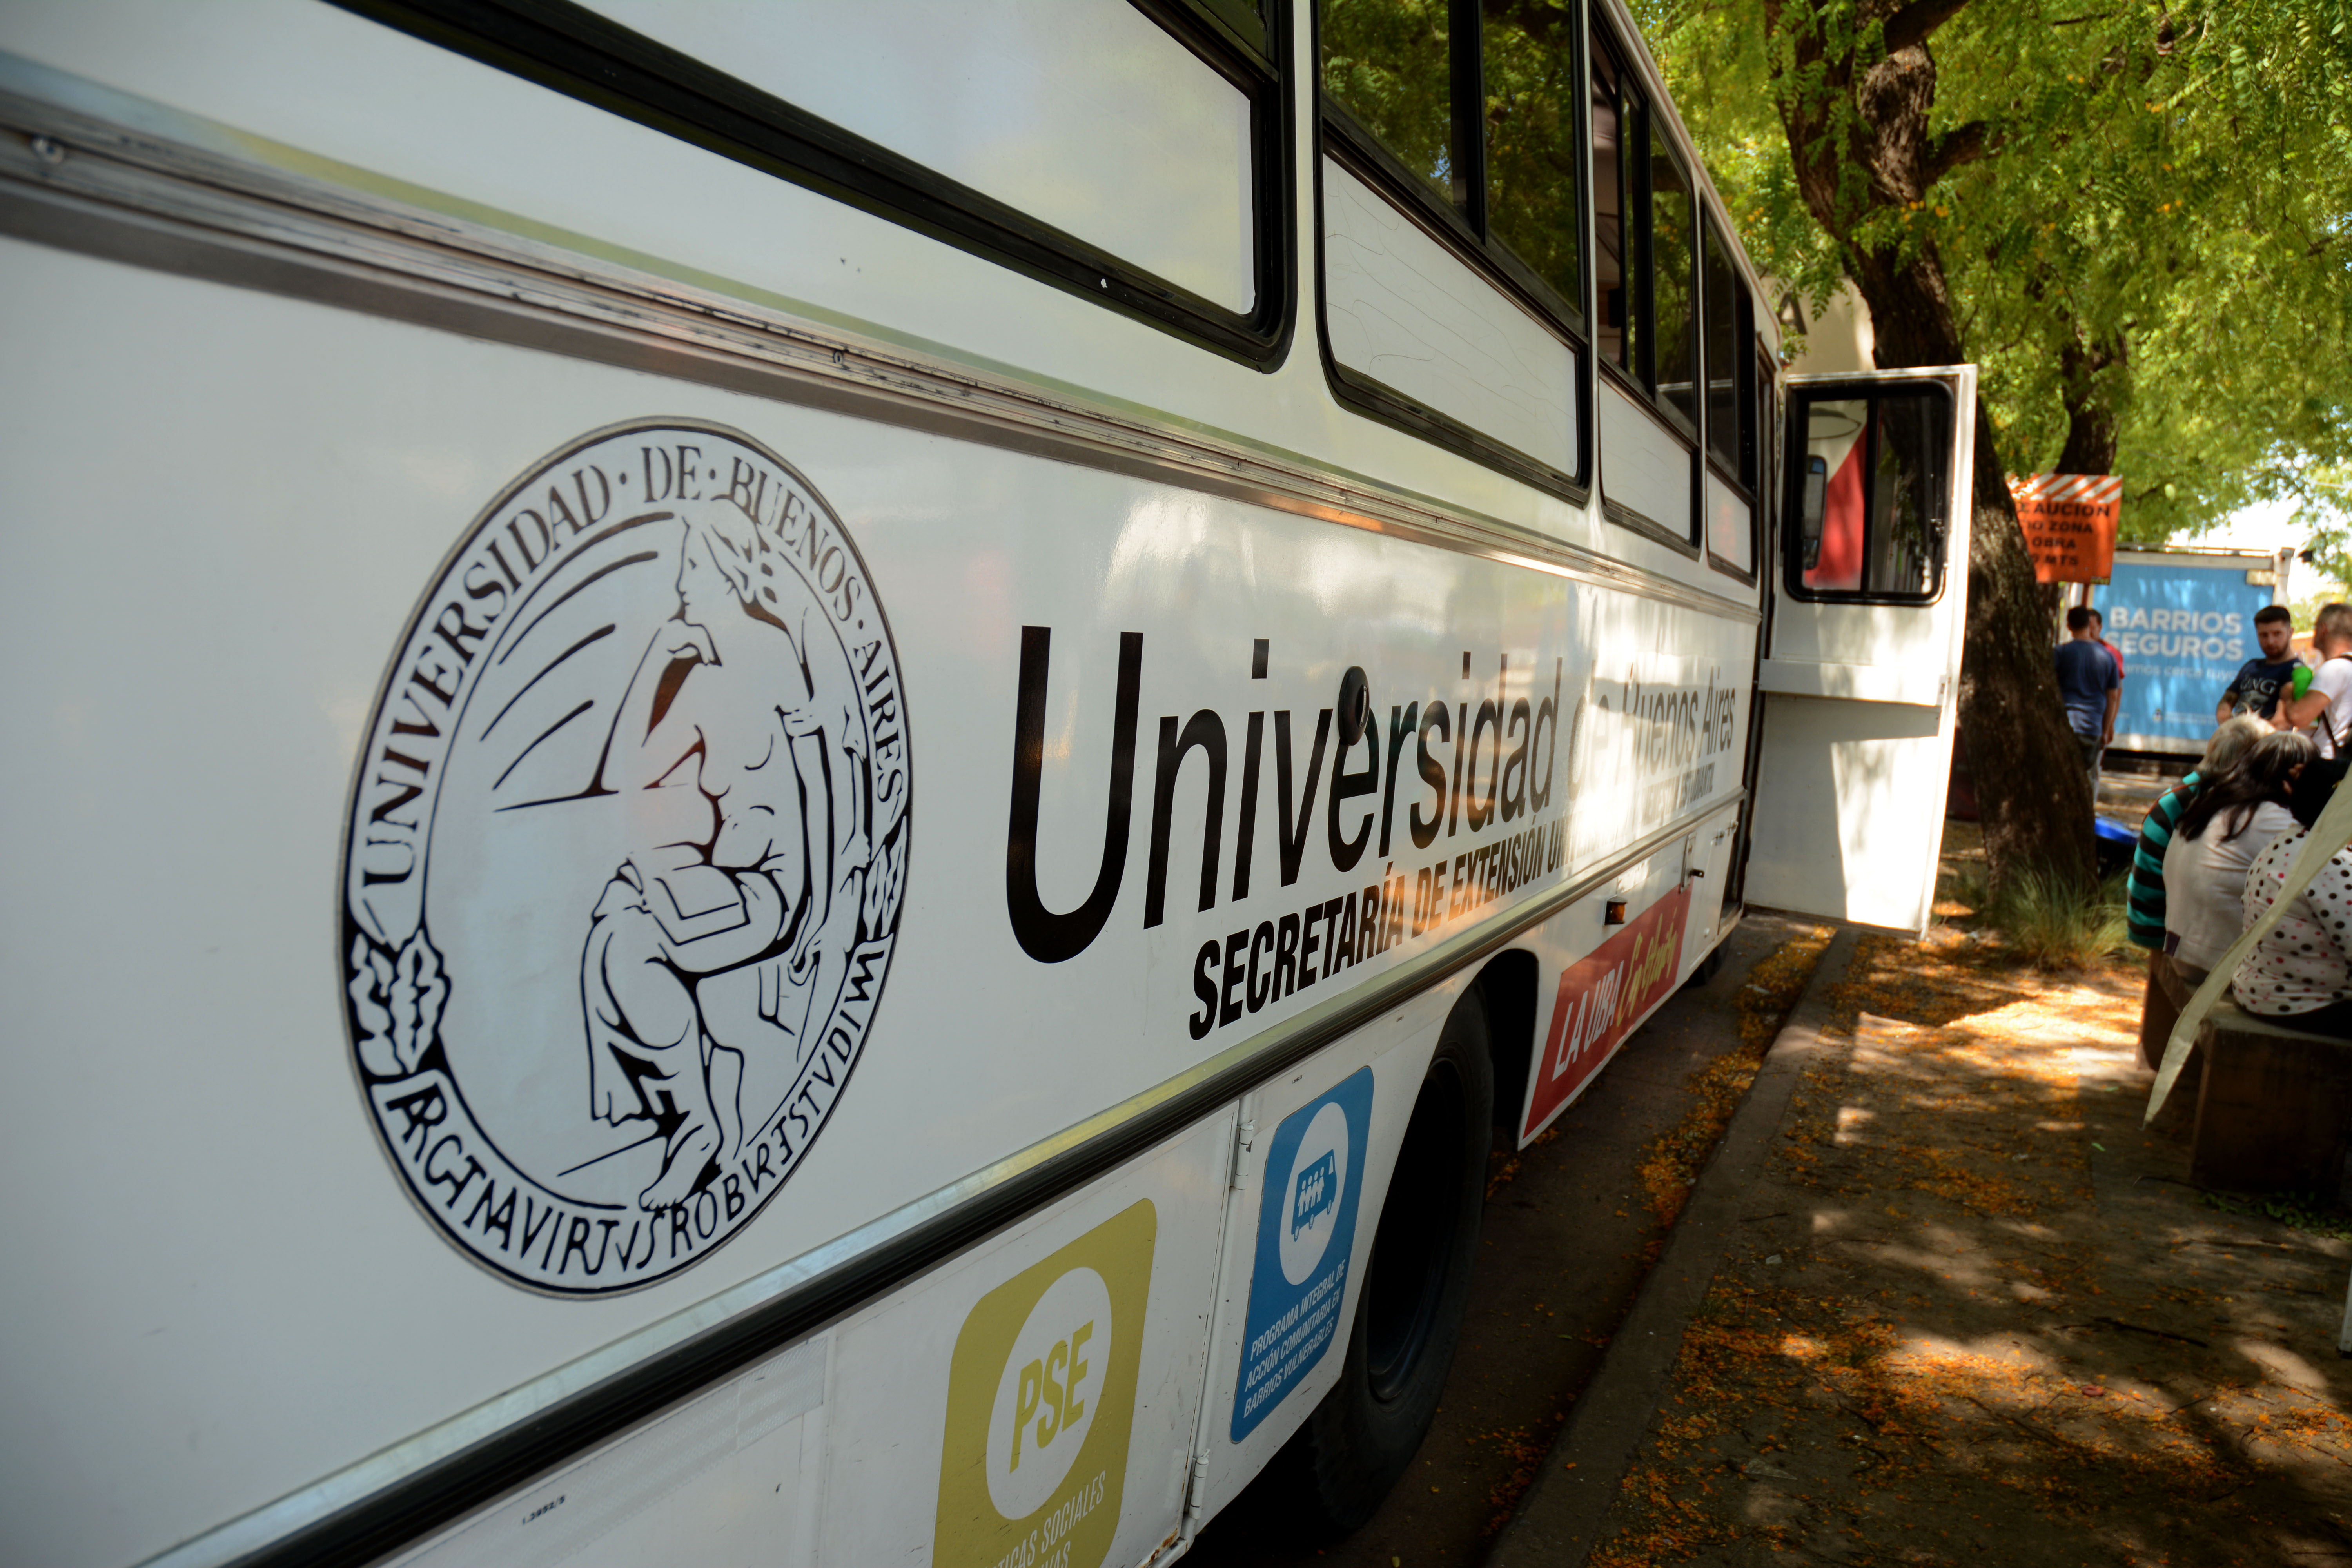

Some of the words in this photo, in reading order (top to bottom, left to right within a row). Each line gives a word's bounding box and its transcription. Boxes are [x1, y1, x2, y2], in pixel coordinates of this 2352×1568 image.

[2049, 520, 2092, 534] ZONA
[363, 465, 610, 888] UNIVERSIDAD
[641, 445, 702, 503] DE
[726, 456, 861, 622] BUENOS
[852, 640, 903, 803] AIRES
[2103, 631, 2244, 661] SEGUROS
[2109, 606, 2243, 635] BARRIOS
[1006, 626, 1563, 964] Universidad
[1615, 662, 1699, 785] Buenos
[1699, 666, 1735, 758] Aires
[1189, 862, 1403, 1040] SECRETARÍA
[1412, 862, 1447, 939] DE
[1449, 817, 1547, 916] EXTENSIÓN
[1552, 990, 1588, 1082] LA
[1584, 960, 1624, 1053] UBA
[1244, 1347, 1280, 1392] ACCIÓN
[1280, 1297, 1331, 1360] COMUNITARIA
[1331, 1286, 1341, 1310] EN
[1250, 1304, 1299, 1361] PROGRAMA
[1300, 1270, 1334, 1317] INTEGRAL
[1335, 1258, 1346, 1282] DE
[1009, 1320, 1094, 1474] PSE
[1243, 1368, 1283, 1419] BARRIOS
[1283, 1316, 1335, 1381] VULNERABLES
[1041, 1470, 1106, 1554] SOCIALES
